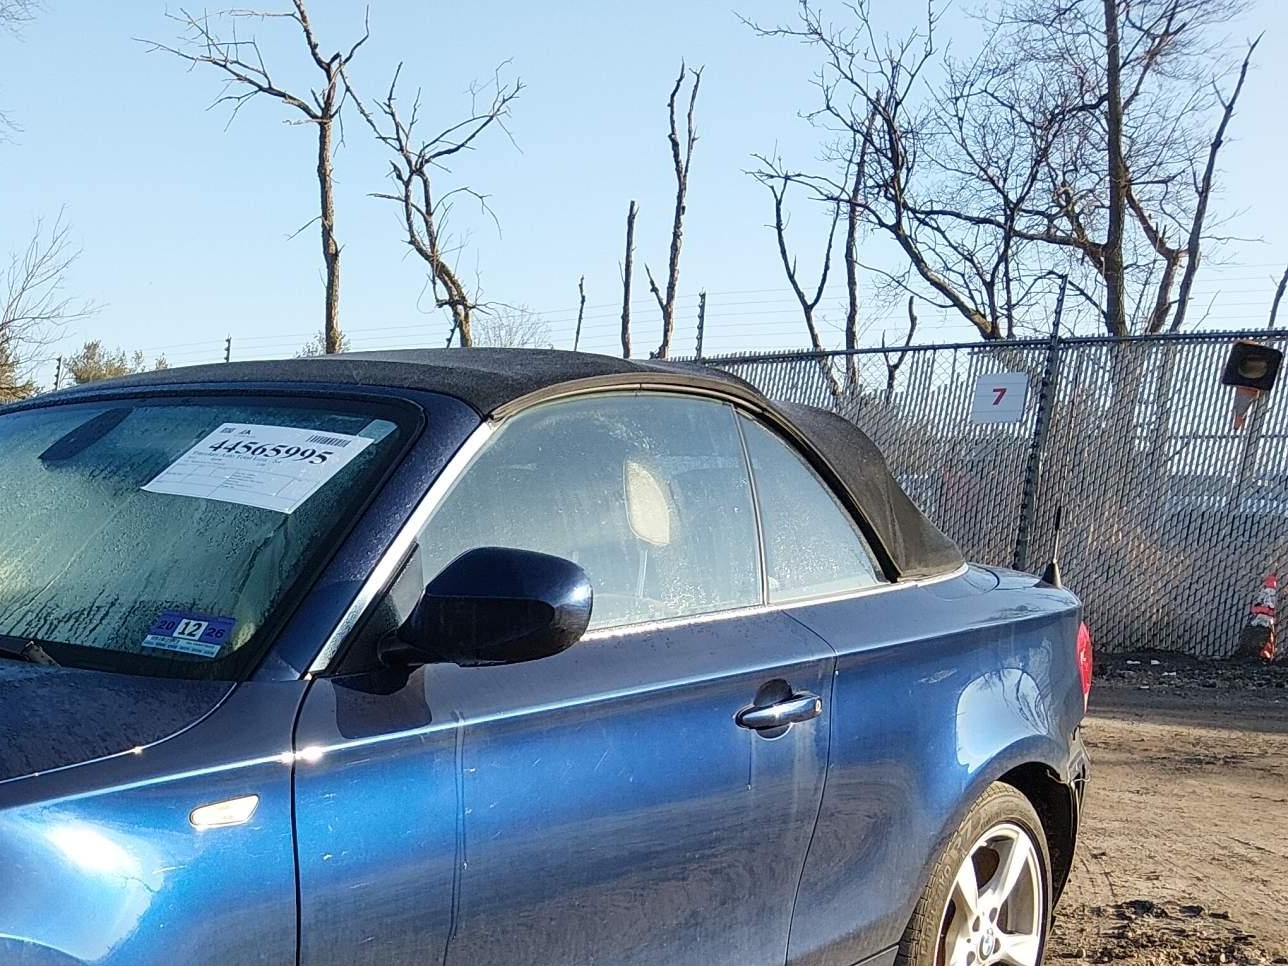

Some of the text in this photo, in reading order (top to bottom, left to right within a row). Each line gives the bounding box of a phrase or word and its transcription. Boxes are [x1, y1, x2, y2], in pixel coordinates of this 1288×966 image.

[992, 387, 1007, 405] 7
[209, 439, 335, 465] 44565995
[178, 620, 203, 638] 12
[206, 627, 225, 639] 26
